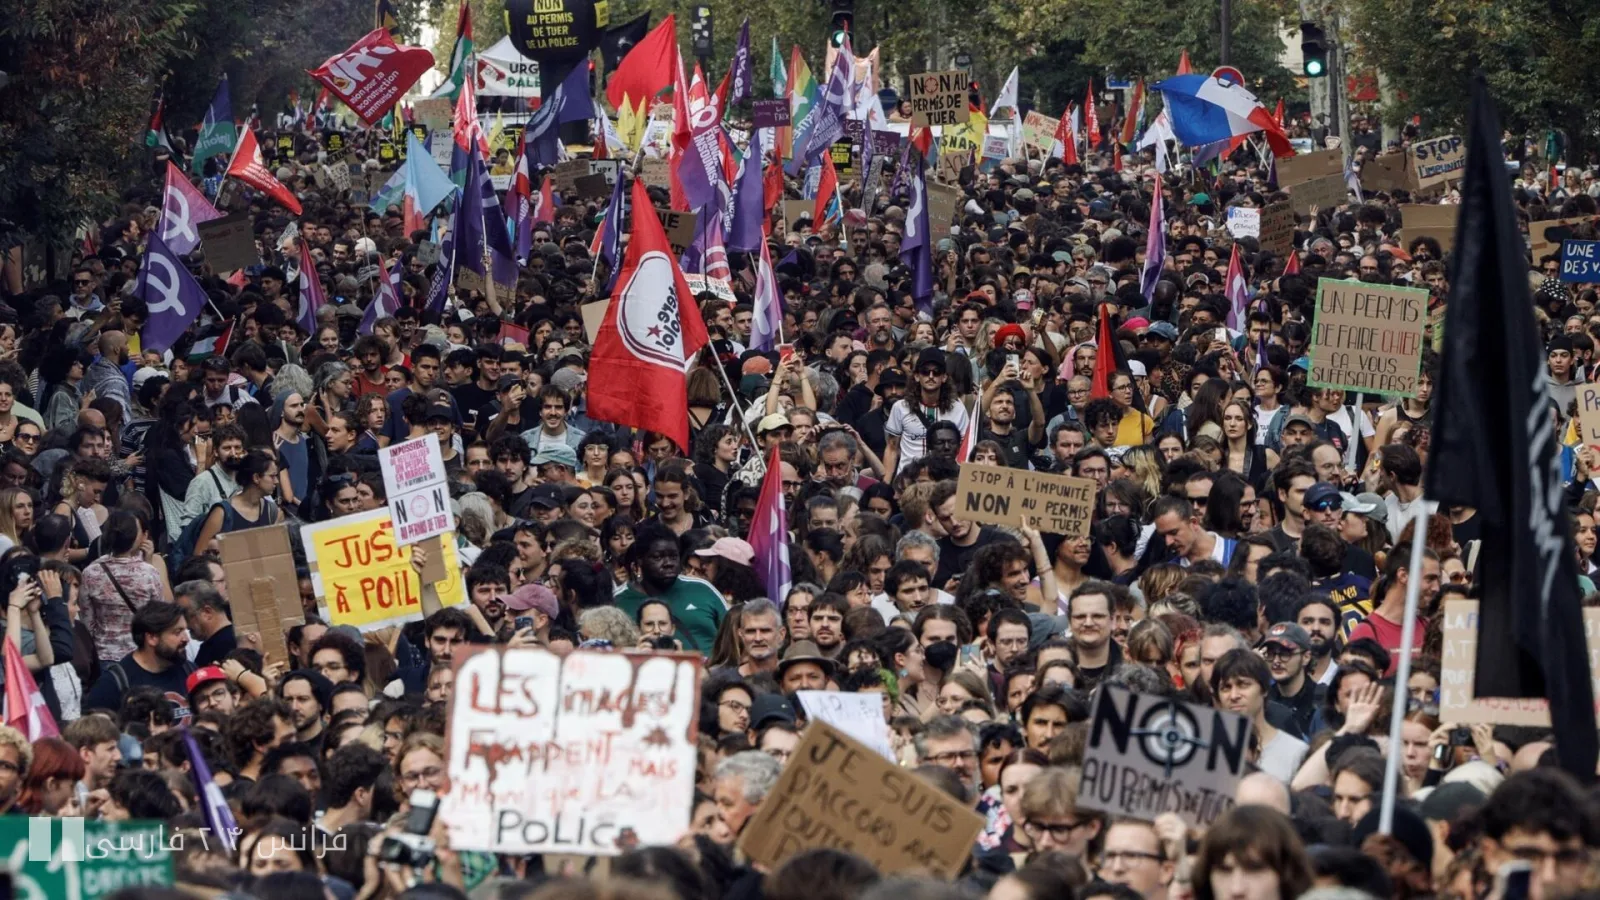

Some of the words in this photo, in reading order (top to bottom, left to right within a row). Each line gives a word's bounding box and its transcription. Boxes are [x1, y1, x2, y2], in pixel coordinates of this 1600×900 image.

[526, 15, 537, 25] AU
[539, 12, 574, 24] PERMIS
[533, 27, 544, 37] DE
[546, 26, 568, 36] TUER
[538, 40, 547, 48] LA
[549, 37, 579, 48] POLICE
[508, 63, 540, 74] URG
[507, 77, 541, 87] PALE
[914, 74, 951, 95] NON
[953, 73, 968, 91] AU
[913, 95, 944, 112] PERMIS
[947, 94, 961, 108] DE
[926, 110, 957, 125] TUER
[703, 130, 720, 164] FRANC
[1416, 136, 1462, 160] STOP
[693, 134, 719, 187] INSOUMISE
[1567, 244, 1595, 258] UNE
[1564, 260, 1589, 275] DES
[1320, 289, 1345, 315] UN
[1353, 292, 1420, 323] PERMIS
[1315, 322, 1335, 347] DE
[1336, 324, 1379, 352] FAIRE
[1381, 329, 1420, 357] CHIER
[1359, 354, 1398, 374] VOUS
[1312, 366, 1377, 389] SUFFISAIT
[1380, 374, 1416, 393] PAS?
[389, 438, 427, 457] IMPOSSIBLE
[403, 457, 428, 472] PEUPLE
[404, 464, 431, 480] MARCHE
[970, 470, 1001, 486] STOP
[1006, 472, 1014, 488] À
[1024, 477, 1090, 501] L'IMPUNITÉ
[395, 488, 445, 525] NON
[966, 491, 1011, 516] NON
[1021, 498, 1037, 510] AU
[1045, 501, 1089, 520] PERMIS
[408, 521, 427, 537] PERMIS
[434, 514, 448, 530] TUER
[1029, 516, 1042, 527] DE
[1051, 518, 1082, 533] TUER
[324, 521, 403, 569] JUS
[333, 582, 350, 613] À
[360, 570, 418, 611] POIL
[470, 671, 540, 718] LES
[1089, 685, 1249, 776] NON
[464, 728, 622, 773] FRAPPENT
[628, 758, 680, 778] MAIS
[808, 728, 865, 784] JE
[880, 769, 954, 834] SUIS
[1080, 757, 1118, 805] AU
[496, 808, 640, 848] POLIC
